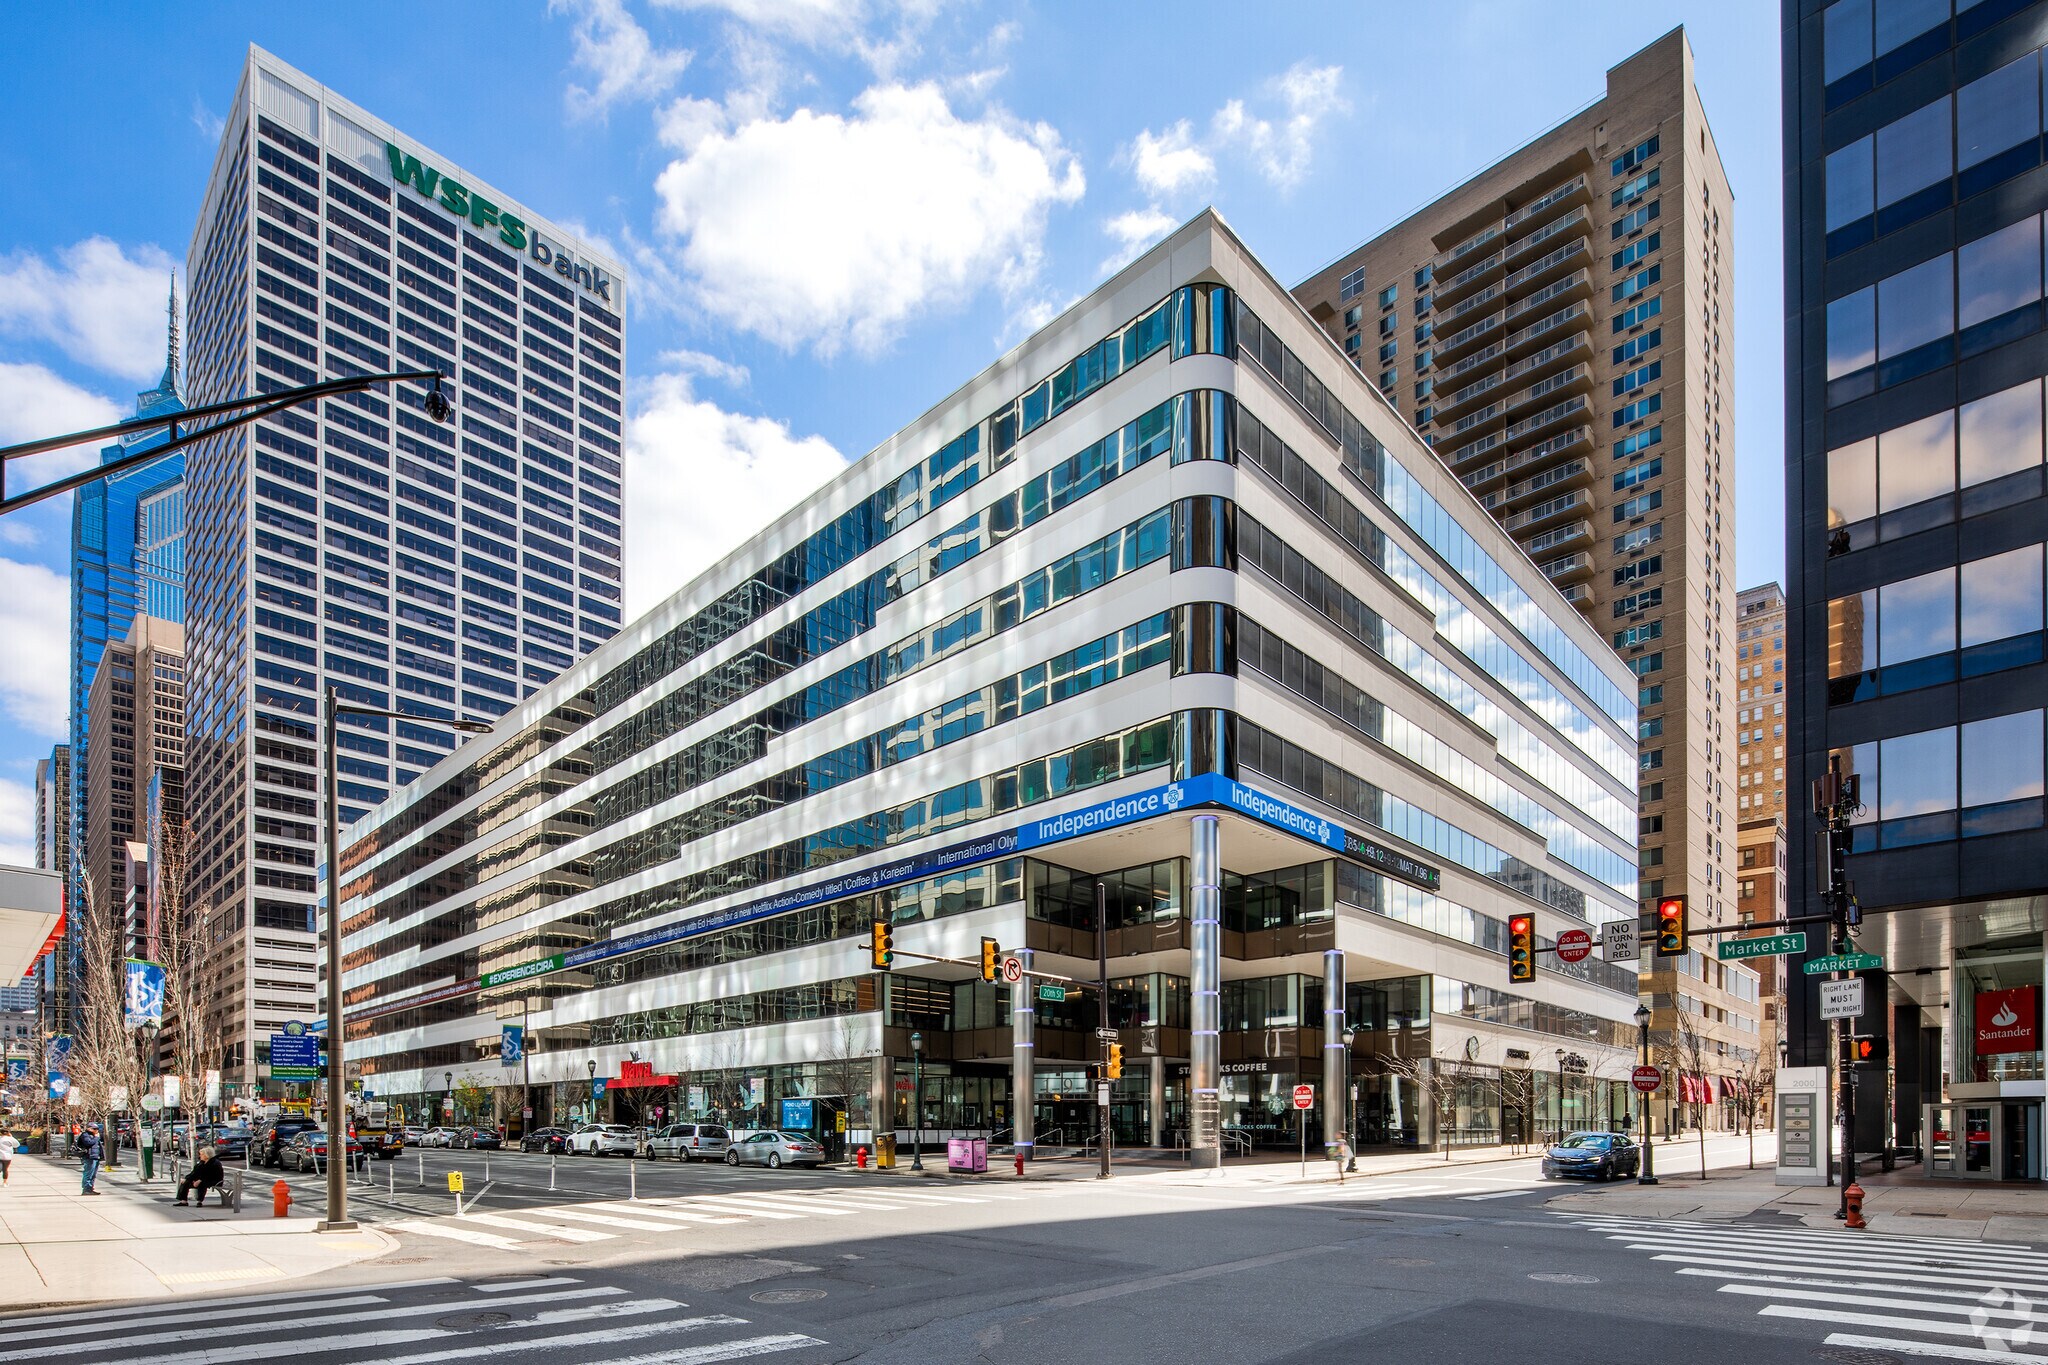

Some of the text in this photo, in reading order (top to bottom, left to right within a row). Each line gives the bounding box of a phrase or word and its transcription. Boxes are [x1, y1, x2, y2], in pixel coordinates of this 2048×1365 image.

[386, 141, 611, 301] WSFS bank
[1232, 783, 1316, 835] Independence
[1039, 793, 1159, 840] Independence
[938, 838, 995, 865] International
[697, 920, 705, 929] Ed
[706, 915, 723, 927] Helms
[724, 912, 733, 921] for
[740, 909, 751, 917] new
[753, 902, 771, 914] Netflix
[773, 888, 823, 909] Action-Comedy
[825, 881, 843, 894] titled
[844, 874, 871, 890] 'Coffee
[872, 872, 879, 883] &
[880, 862, 915, 881] Kareem'
[1612, 924, 1629, 934] NO
[1609, 934, 1633, 943] TURN
[1613, 950, 1631, 958] RED
[1725, 938, 1797, 956] Market St
[489, 959, 554, 985] #EXPERIENCE CIRA
[1810, 959, 1879, 972] MARKET ST
[1043, 988, 1056, 997] 20th
[1823, 983, 1860, 993] RIGHT LANE
[1831, 994, 1853, 1003] MUST
[1843, 1004, 1861, 1013] RIGHT
[1979, 1025, 2032, 1041] Santander
[621, 1061, 652, 1079] Wawa
[1232, 1063, 1267, 1072] COFFEE
